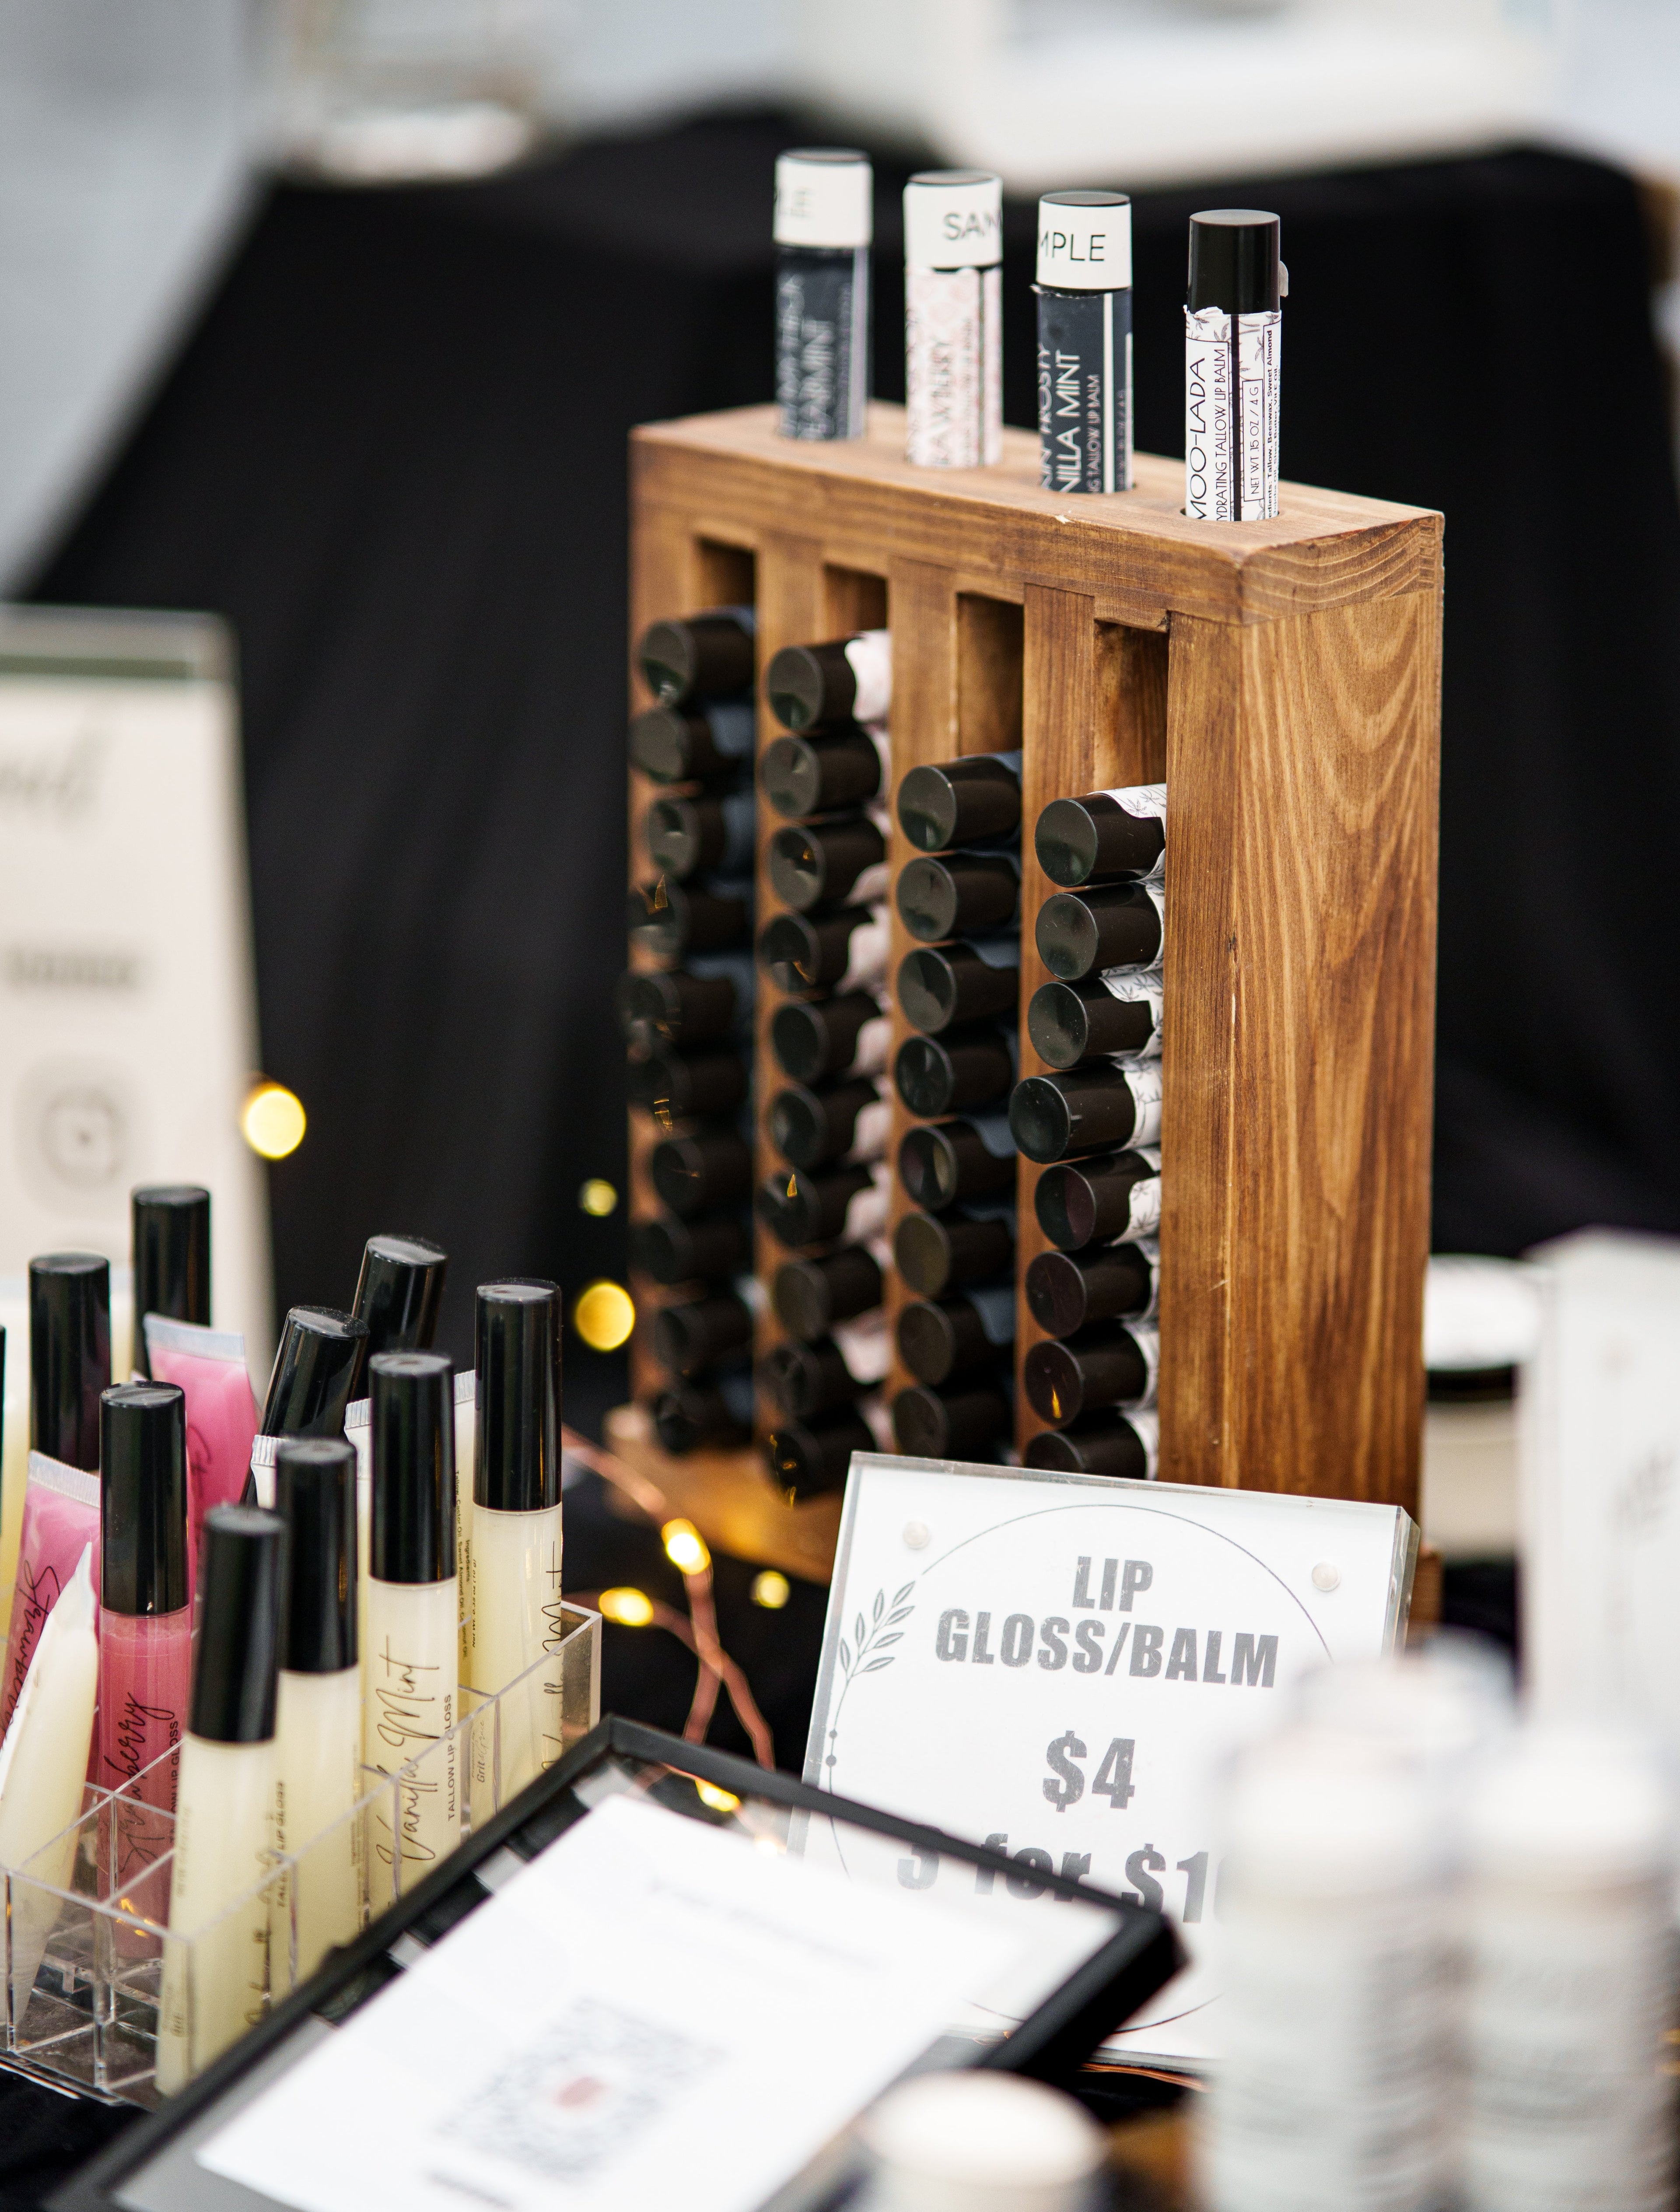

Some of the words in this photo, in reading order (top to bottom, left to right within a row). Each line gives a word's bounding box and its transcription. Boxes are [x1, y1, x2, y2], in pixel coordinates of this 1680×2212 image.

[1055, 349, 1081, 417] MINT
[1214, 349, 1225, 382] BALM
[1087, 374, 1100, 408] BALM
[1214, 387, 1226, 400] LIP
[1250, 387, 1259, 396] G
[1087, 410, 1101, 424] LIP
[1215, 405, 1227, 457] TALLOW
[1250, 420, 1259, 436] OZ
[1087, 427, 1101, 477] TALLOW
[1250, 440, 1259, 452] .15
[1250, 456, 1259, 473] WT
[1251, 477, 1259, 494] NET
[1072, 1556, 1153, 1612] LIP
[935, 1608, 1279, 1689] GLOSS/BALM
[375, 1635, 440, 1747] Mint
[104, 1692, 175, 1872] Strawberry
[476, 1760, 485, 1782] Grit
[1042, 1730, 1136, 1812] $4
[376, 1756, 438, 1864] Vanilla
[974, 1833, 1091, 1902] for
